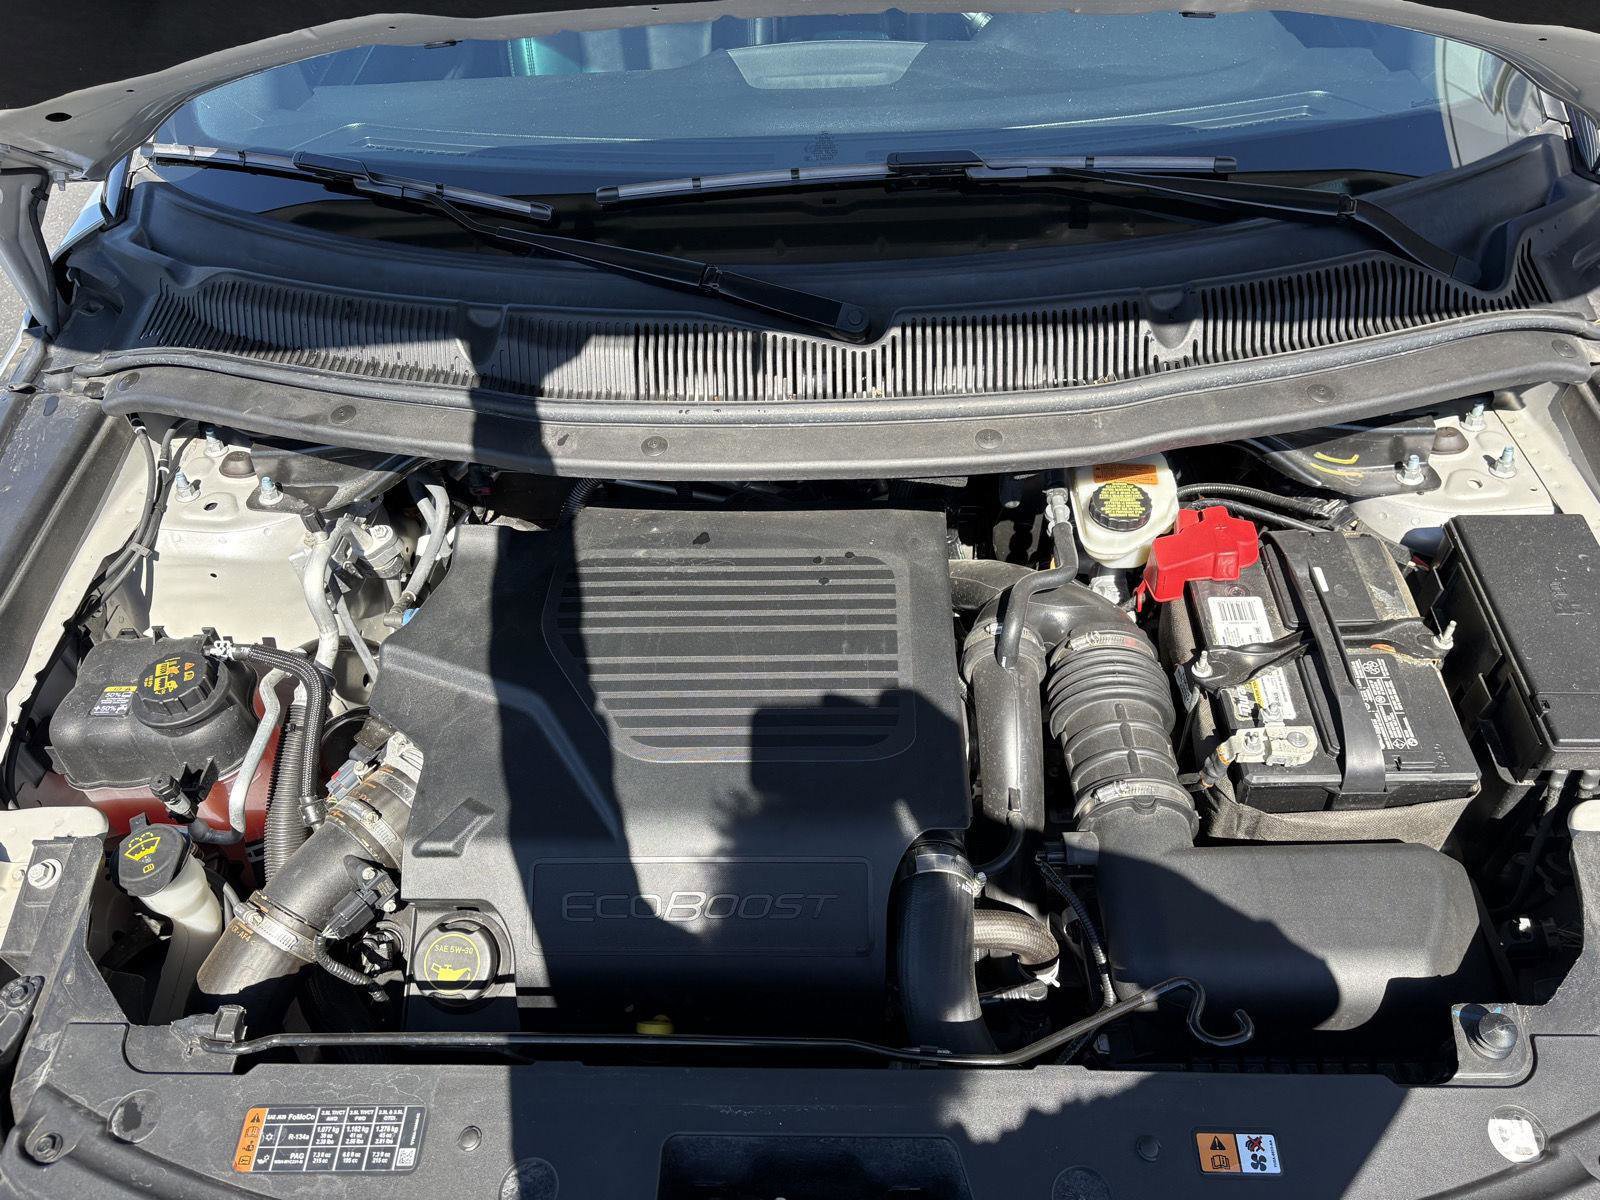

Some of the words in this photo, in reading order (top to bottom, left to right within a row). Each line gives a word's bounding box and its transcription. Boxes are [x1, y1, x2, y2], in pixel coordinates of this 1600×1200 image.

[434, 944, 449, 953] SAE
[449, 945, 474, 955] 5W-30
[288, 1113, 315, 1121] FoMoCo
[332, 1126, 340, 1134] kg
[362, 1126, 369, 1134] kg
[391, 1126, 399, 1134] kg
